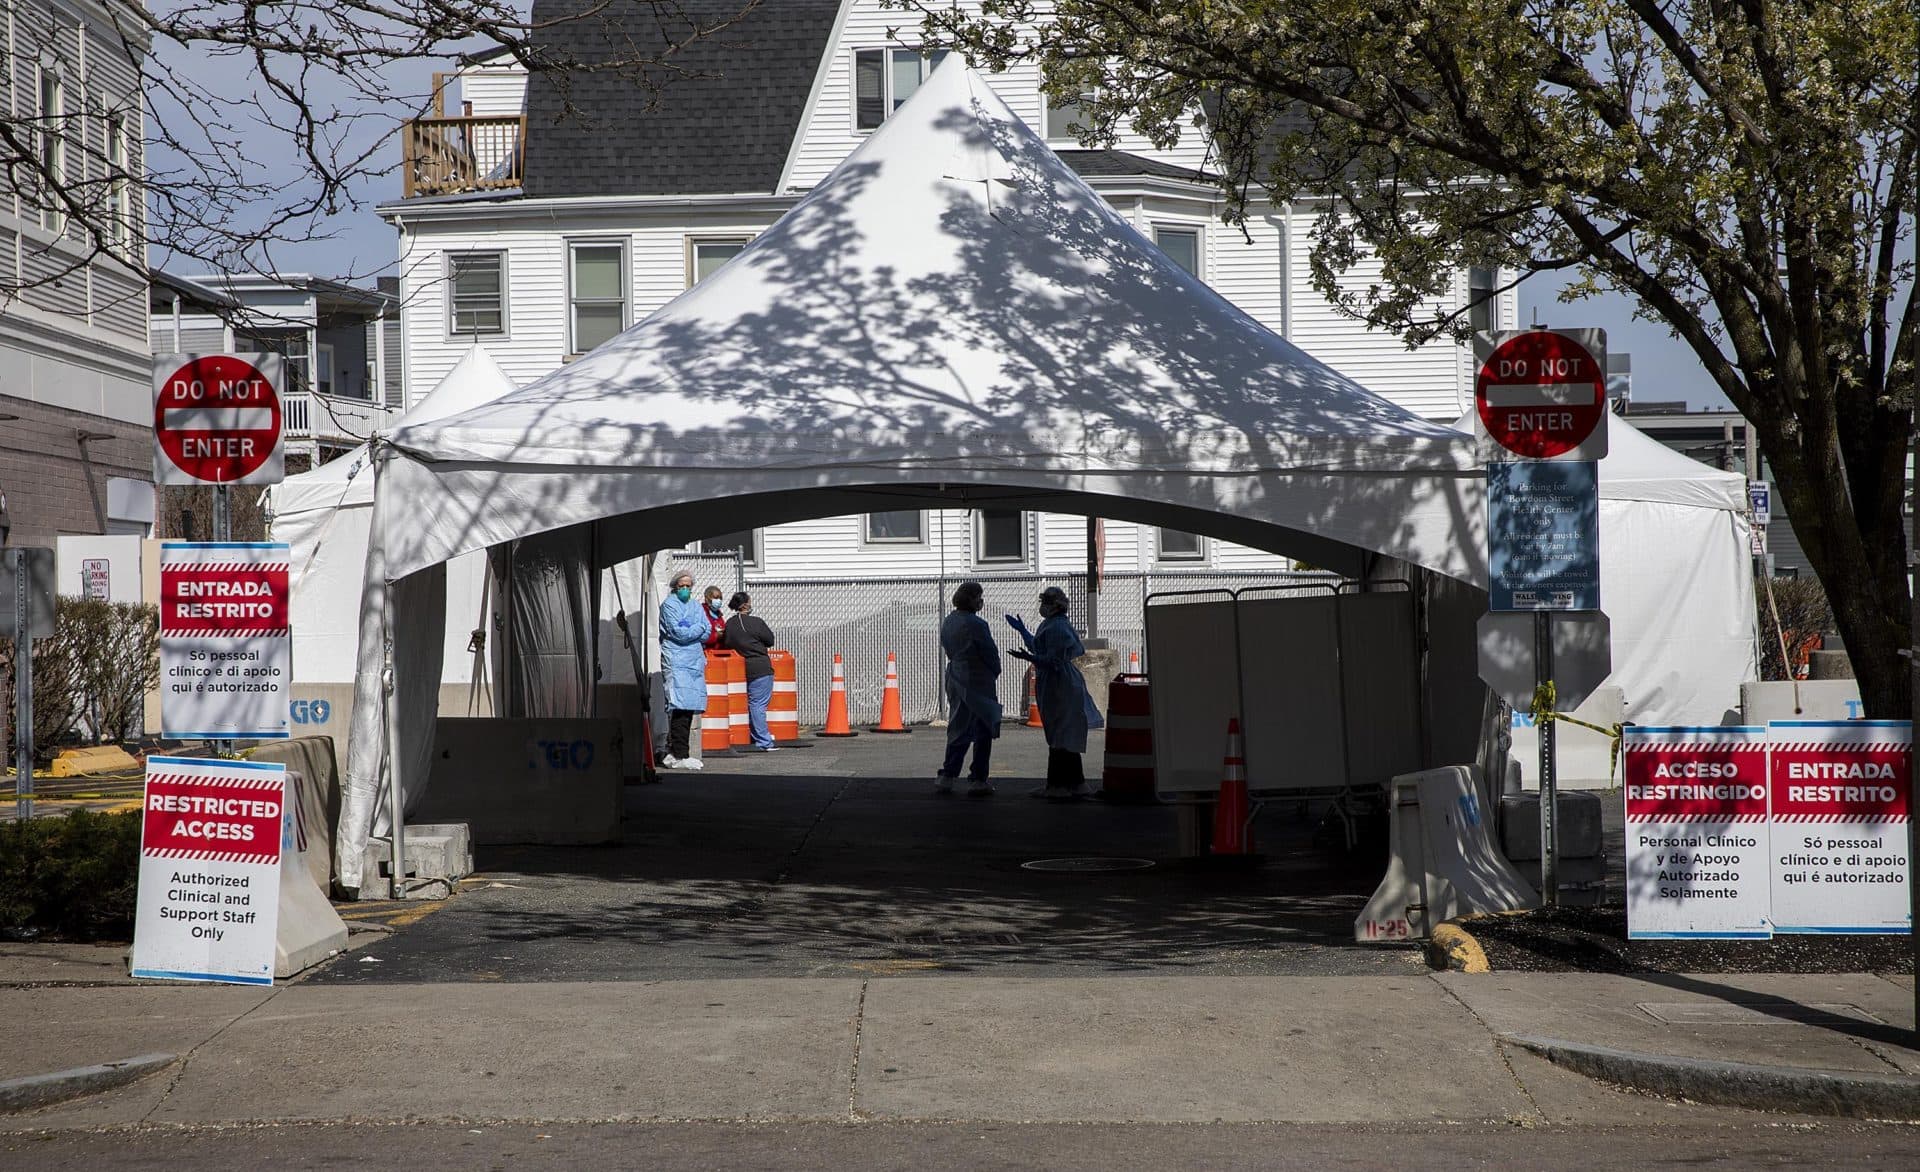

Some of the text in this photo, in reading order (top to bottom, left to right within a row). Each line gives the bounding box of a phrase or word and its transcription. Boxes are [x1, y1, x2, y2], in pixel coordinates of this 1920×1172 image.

[1500, 358, 1581, 378] DO NOT
[173, 380, 262, 400] DO NOT
[1507, 413, 1573, 432] ENTER
[183, 438, 254, 458] ENTER
[1519, 482, 1567, 492] Parking for
[1549, 494, 1574, 503] Street
[1512, 505, 1574, 513] Health Center
[1533, 516, 1552, 527] only
[1517, 531, 1549, 540] resident
[1553, 532, 1572, 540] must
[1541, 552, 1576, 562] nowing)
[90, 562, 102, 570] NO
[177, 582, 273, 597] ENTRADA
[177, 603, 273, 618] RESTRITO
[190, 649, 259, 664] Só pessoal
[169, 665, 281, 680] clínico e di apoio
[172, 680, 278, 696] qui é autorizado
[1655, 762, 1738, 778] ACCESO
[1789, 763, 1895, 779] ENTRADA
[1628, 785, 1766, 801] RESTRINGIDO
[1788, 786, 1896, 802] RESTRITO
[149, 794, 279, 819] RESTRICTED
[172, 821, 254, 841] ACCESS
[1639, 835, 1756, 847] Personal Clínico
[1804, 837, 1882, 851] Só pessoal
[1657, 853, 1740, 866] y de Apoyo
[1780, 854, 1906, 869] clínico e di apoio
[171, 872, 249, 888] Authorized
[1658, 870, 1739, 882] Autorizado
[1783, 871, 1904, 884] qui é autorizado
[168, 889, 250, 906] Clinical and
[1660, 887, 1738, 898] Solamente
[160, 906, 256, 925] Support Staff
[191, 926, 224, 941] Only
